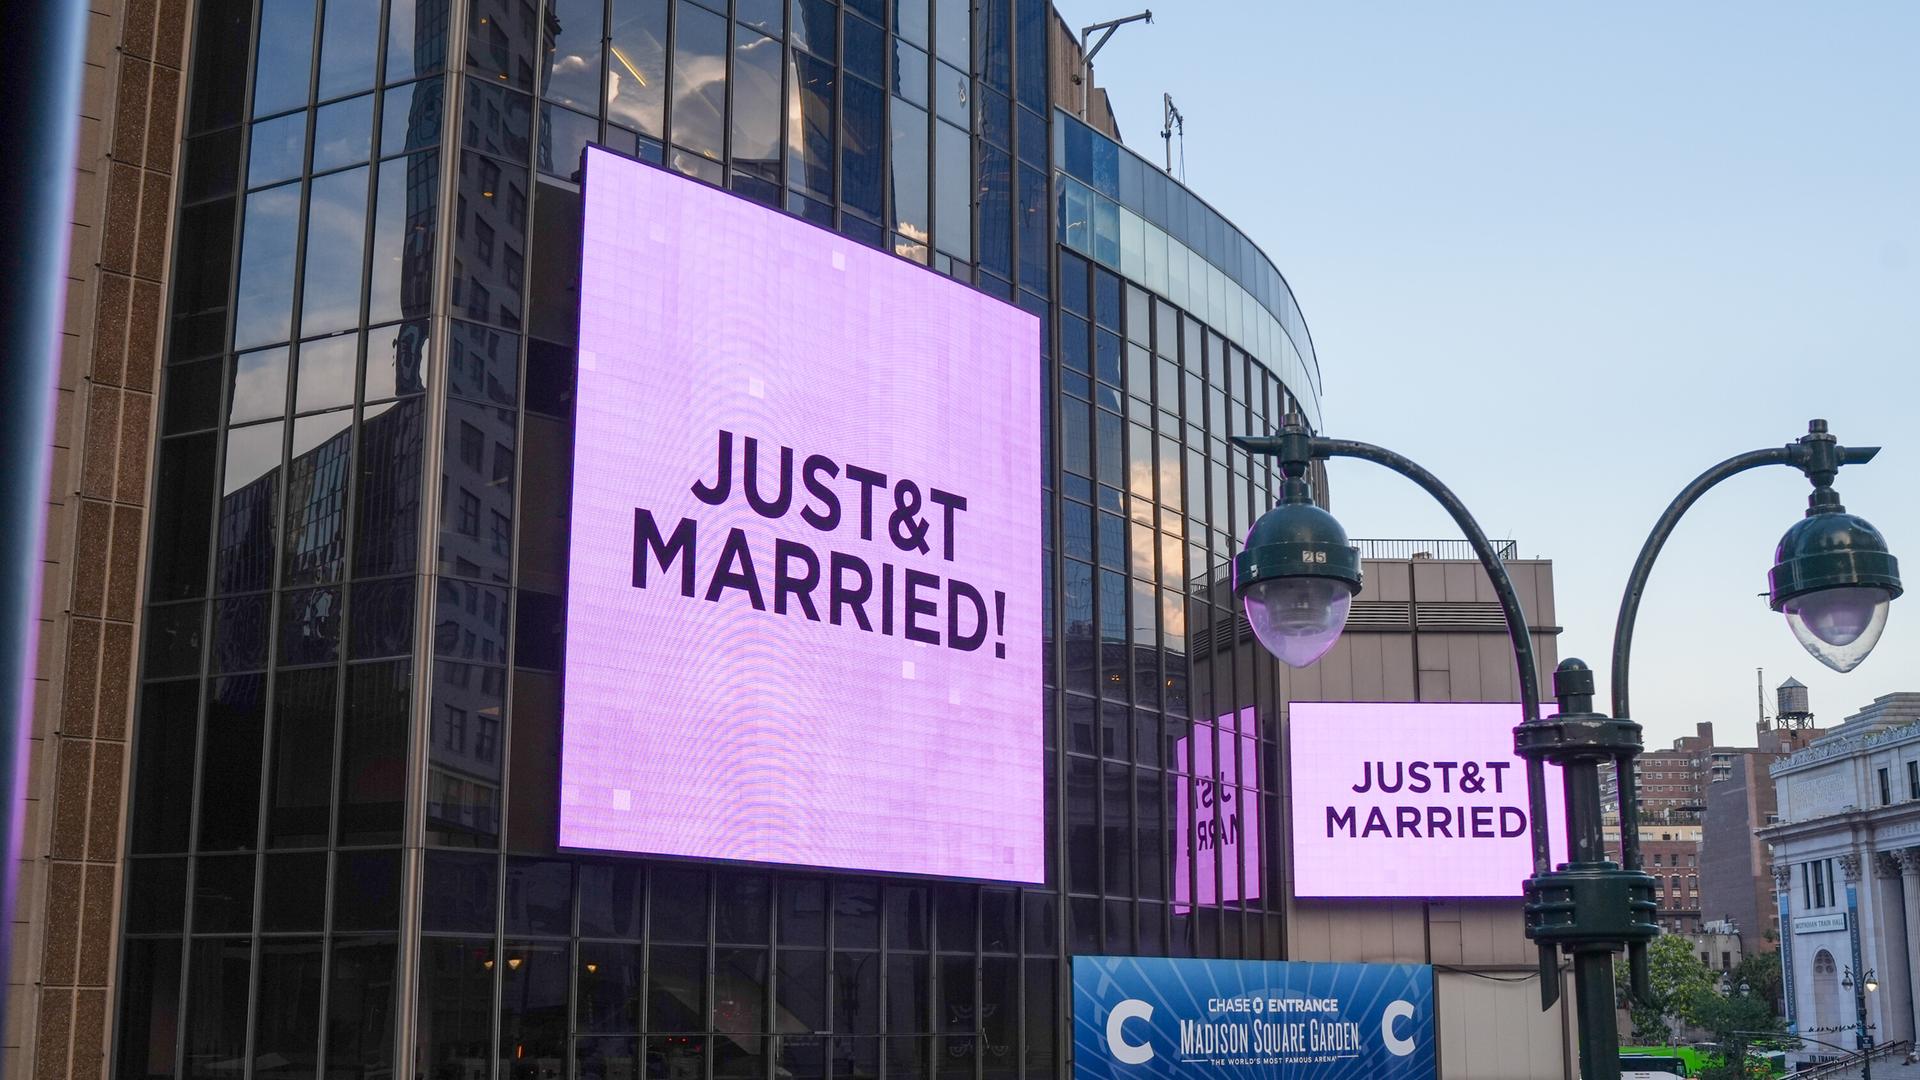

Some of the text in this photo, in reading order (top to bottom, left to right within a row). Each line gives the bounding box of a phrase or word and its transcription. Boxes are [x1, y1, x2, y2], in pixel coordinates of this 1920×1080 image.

[690, 429, 967, 562] JUST&T
[1303, 551, 1325, 563] 25
[632, 506, 1006, 660] MARRIED!
[1352, 761, 1510, 793] JUST&T
[1326, 806, 1527, 838] MARRIED
[1208, 998, 1338, 1012] CHASE ENTRANCE
[1106, 999, 1154, 1065] C
[1180, 1018, 1359, 1056] MADISON SQUARE GARDEN
[1381, 1000, 1416, 1056] C
[1285, 1056, 1312, 1064] FAMOUS
